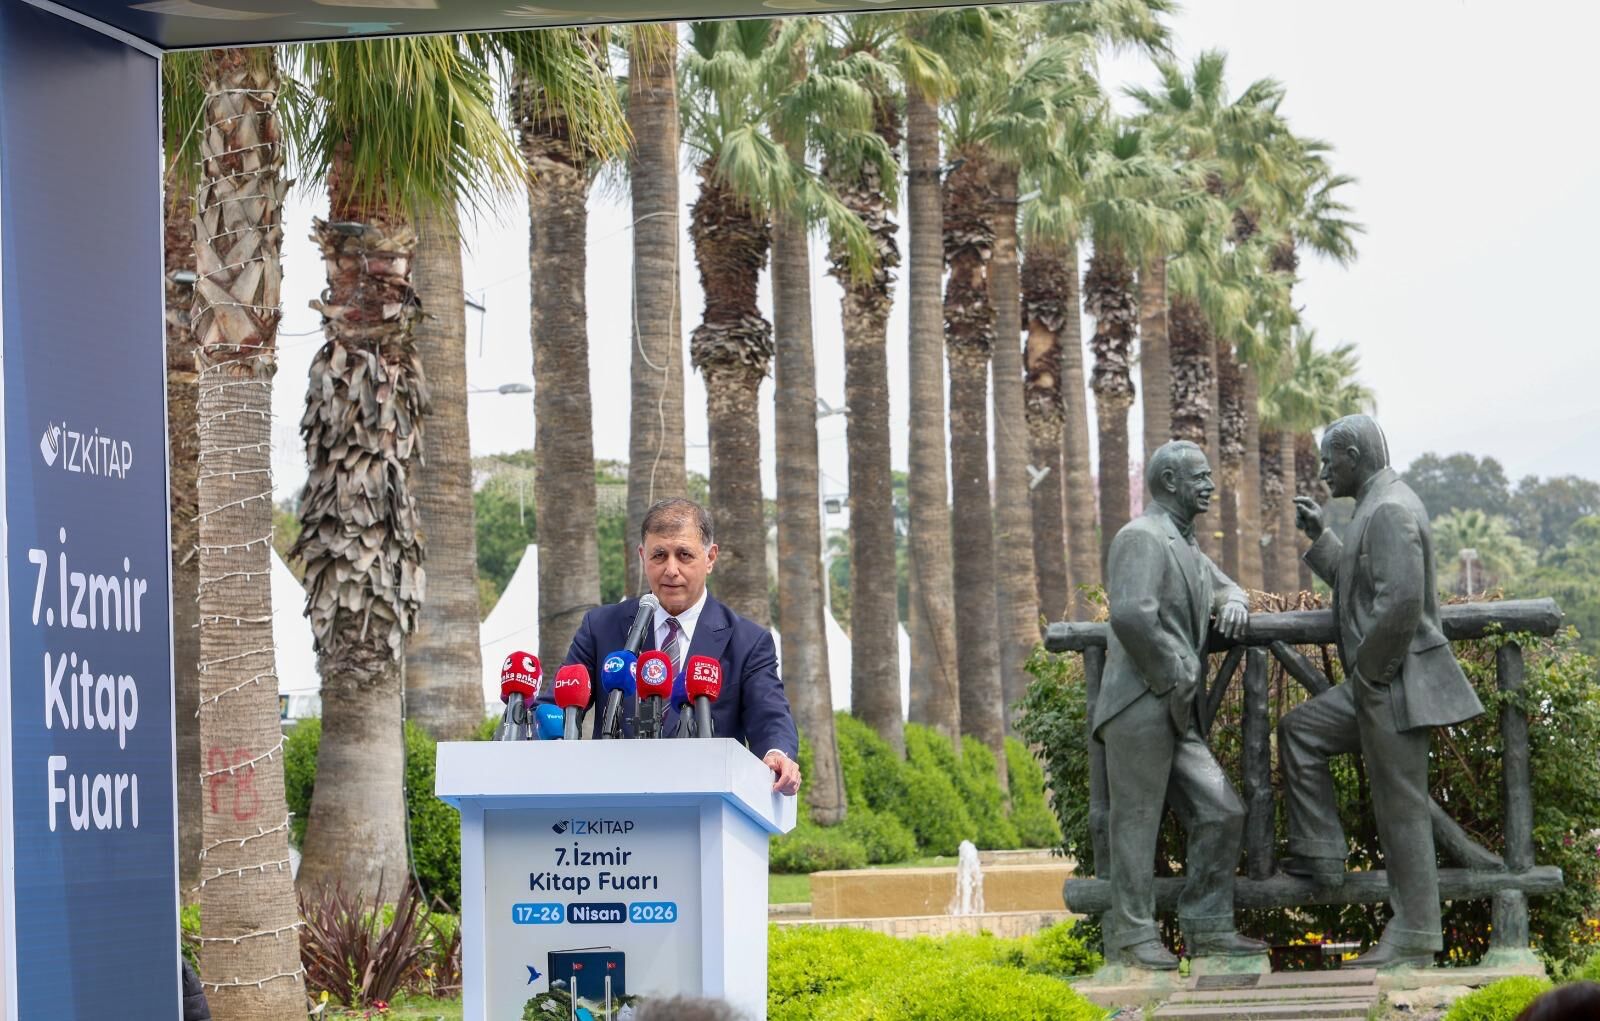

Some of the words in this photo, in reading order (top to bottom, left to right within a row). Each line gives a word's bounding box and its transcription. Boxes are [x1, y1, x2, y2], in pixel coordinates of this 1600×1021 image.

[62, 421, 132, 479] İZKİTAP
[516, 672, 537, 684] anka
[555, 678, 580, 689] DHA
[44, 651, 139, 749] Kitap
[47, 755, 139, 832] Fuarı
[571, 818, 634, 834] İZKİTAP
[529, 872, 591, 895] Kitap
[598, 872, 658, 890] Fuarı
[516, 907, 561, 921] 17-26
[573, 906, 621, 921] Nisan
[632, 905, 674, 920] 2026
